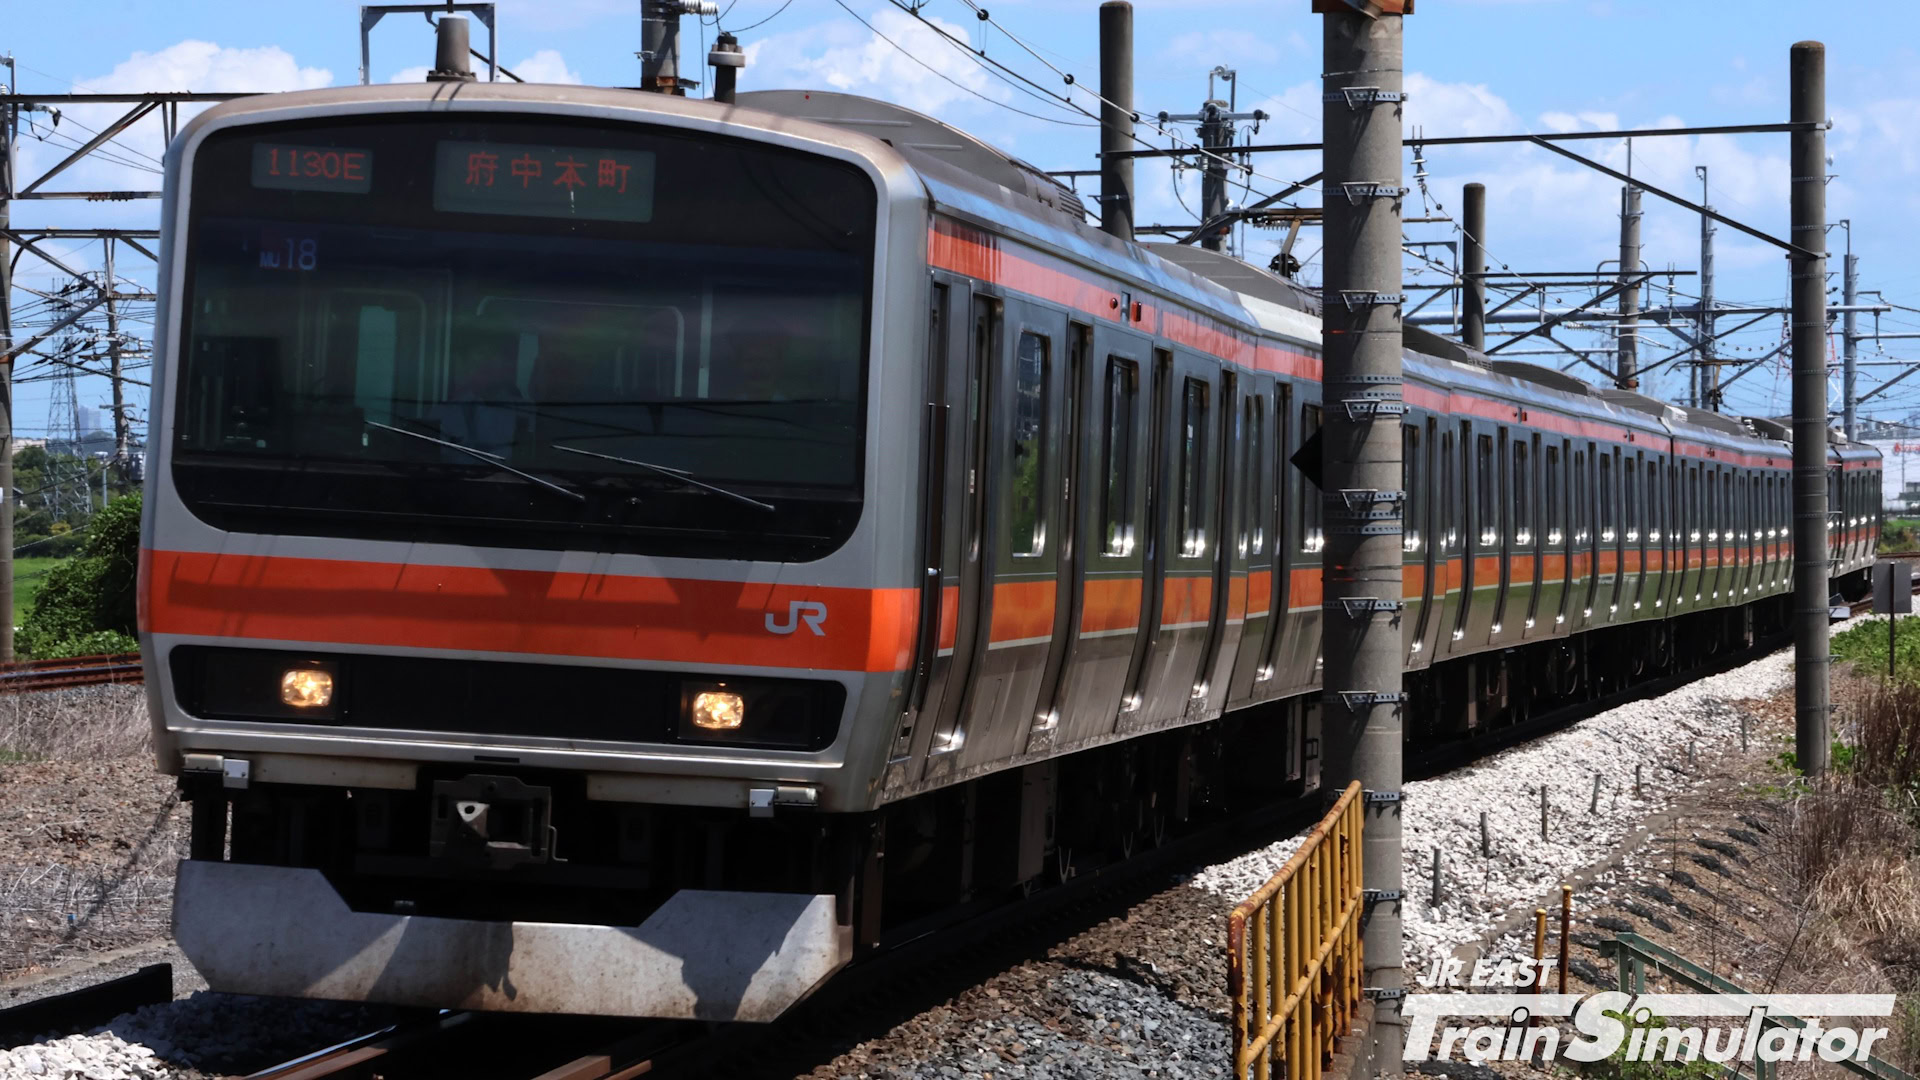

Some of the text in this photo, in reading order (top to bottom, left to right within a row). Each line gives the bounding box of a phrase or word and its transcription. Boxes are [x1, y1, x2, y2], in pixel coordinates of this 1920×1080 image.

[269, 148, 366, 180] 1130E
[465, 151, 632, 194] 府中本町
[765, 600, 827, 636] JR
